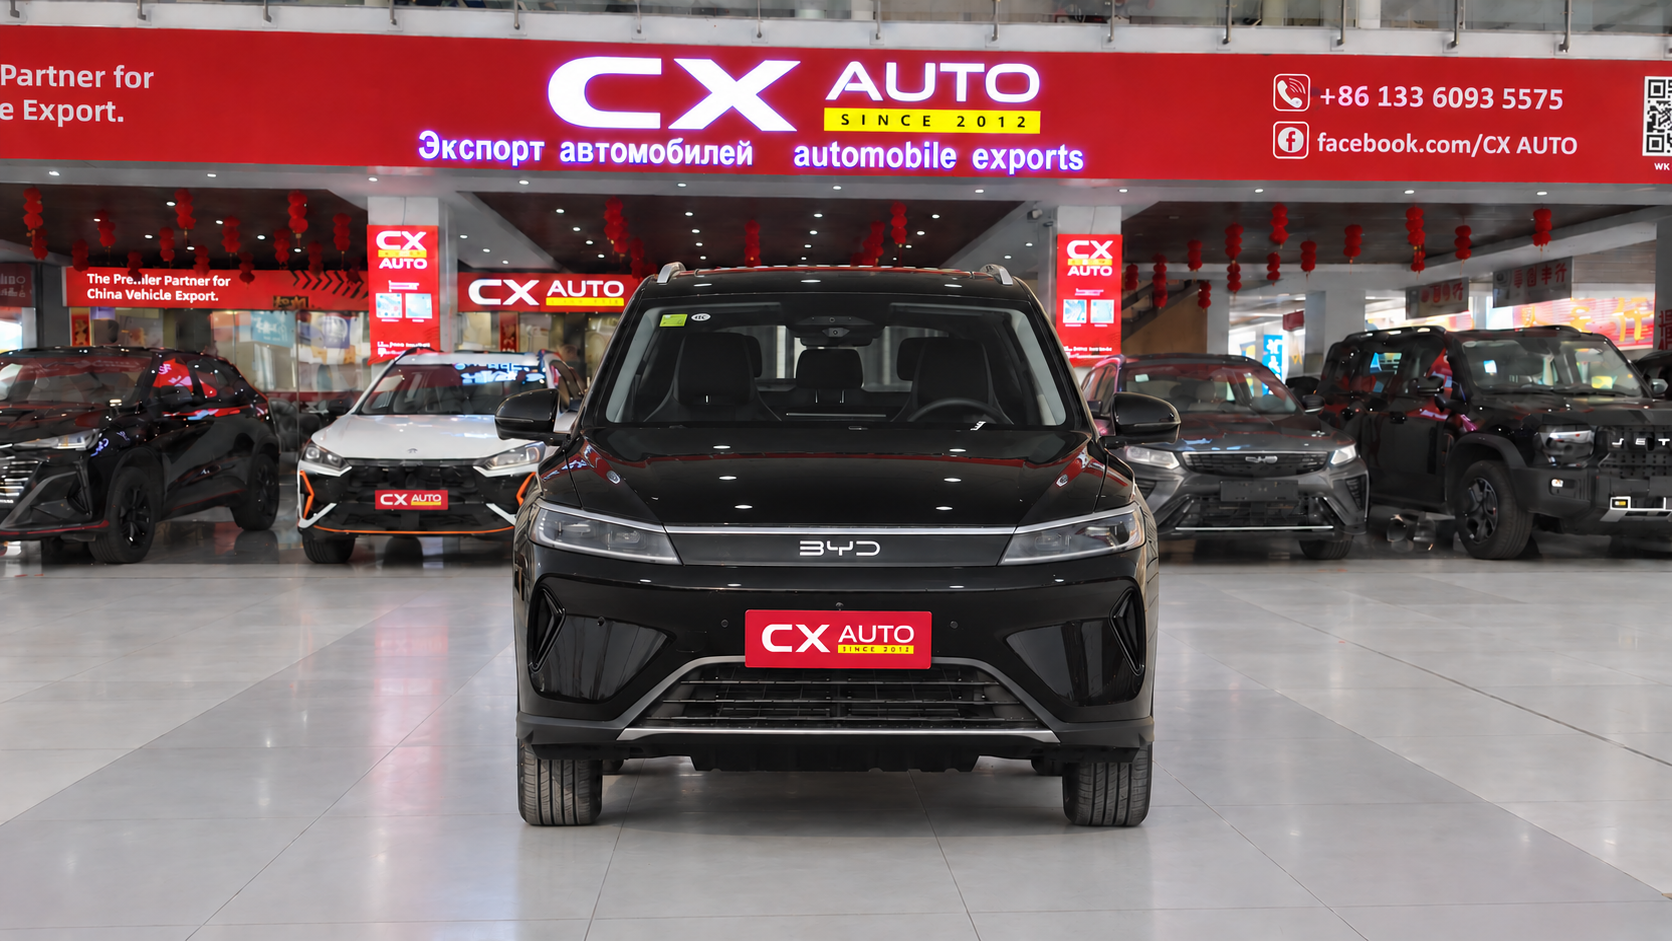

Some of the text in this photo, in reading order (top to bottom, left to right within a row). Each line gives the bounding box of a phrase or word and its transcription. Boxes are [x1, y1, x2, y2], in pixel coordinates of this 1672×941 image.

[1, 64, 154, 89] Partner for
[547, 56, 1040, 133] CX AUTO
[1320, 85, 1564, 110] +86 133 6093 5575
[23, 99, 124, 127] Export.
[841, 113, 1026, 128] SINCE 2012
[418, 130, 753, 167] Экспорт автомобилей
[1317, 132, 1578, 157] facebook.com/CX AUTO
[793, 141, 1084, 175] automobile exports
[376, 230, 427, 250] CX
[1066, 240, 1113, 260] CX
[379, 258, 428, 269] AUTO
[1067, 265, 1113, 276] AUTO
[87, 273, 110, 284] The
[164, 275, 210, 286] Partner
[213, 275, 231, 287] for
[87, 288, 219, 304] China Vehicle Export.
[468, 278, 624, 305] CX AUTO
[380, 493, 442, 506] CX AUTO
[799, 540, 881, 557] BYD
[761, 624, 915, 653] CX AUTO
